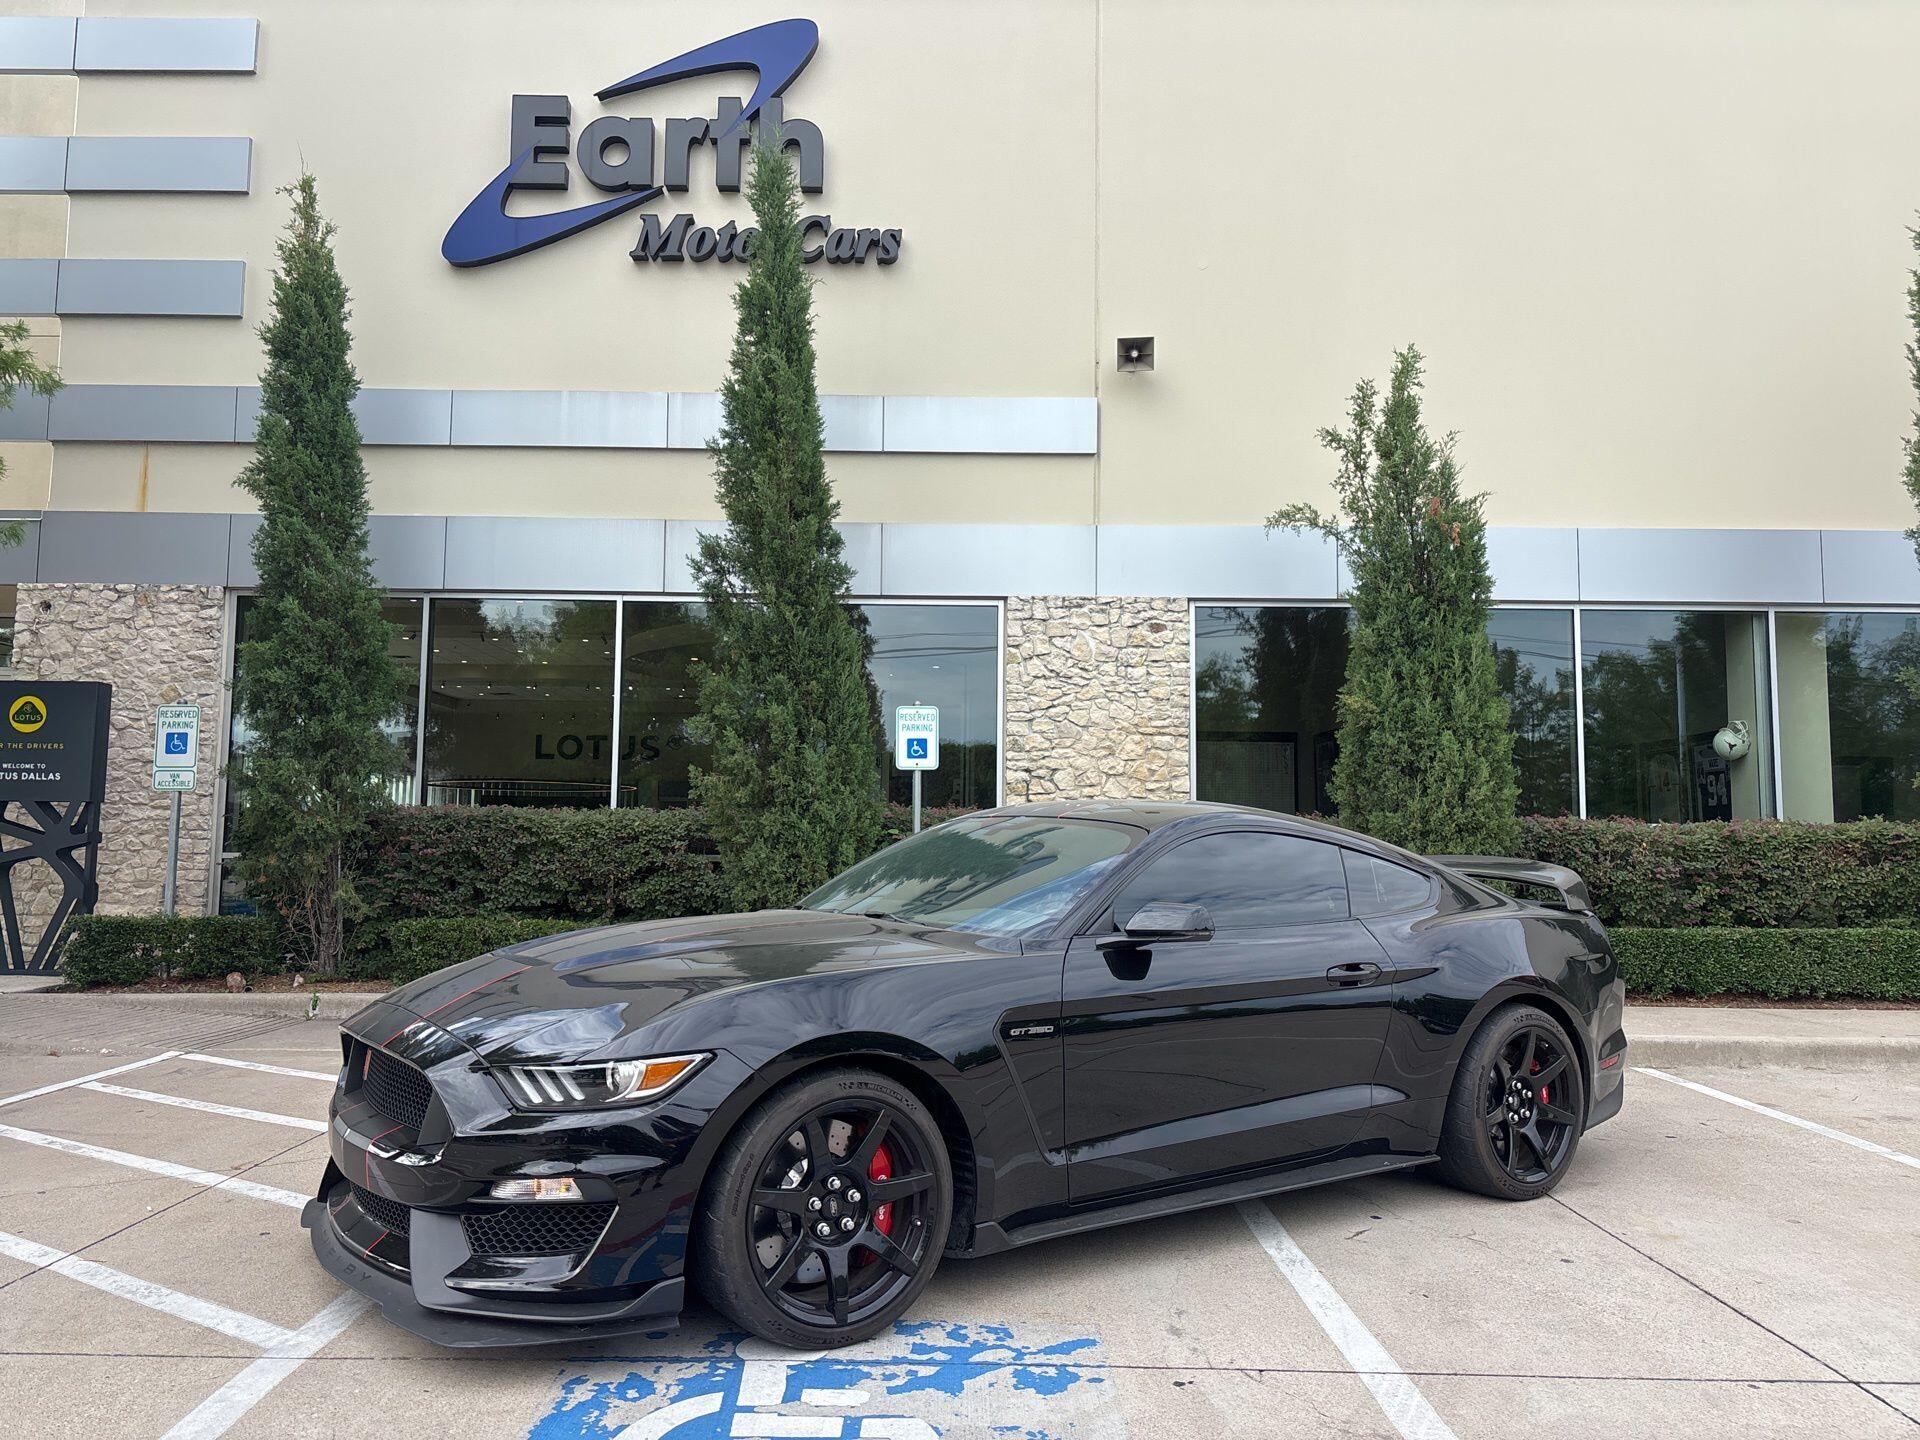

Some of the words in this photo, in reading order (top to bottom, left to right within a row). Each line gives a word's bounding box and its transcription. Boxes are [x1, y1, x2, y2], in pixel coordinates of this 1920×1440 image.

[510, 94, 824, 194] Earth
[629, 213, 759, 263] Moto
[795, 214, 903, 265] Cars
[160, 709, 198, 719] RESERVED
[899, 713, 936, 722] RESERVED
[161, 720, 194, 730] PARKING
[901, 723, 933, 732] PARKING
[26, 742, 65, 750] DRIVERS
[21, 772, 61, 781] DALLAS
[157, 780, 192, 788] ACCESSIBLE
[1707, 773, 1728, 806] 94
[1010, 1026, 1054, 1036] GT350
